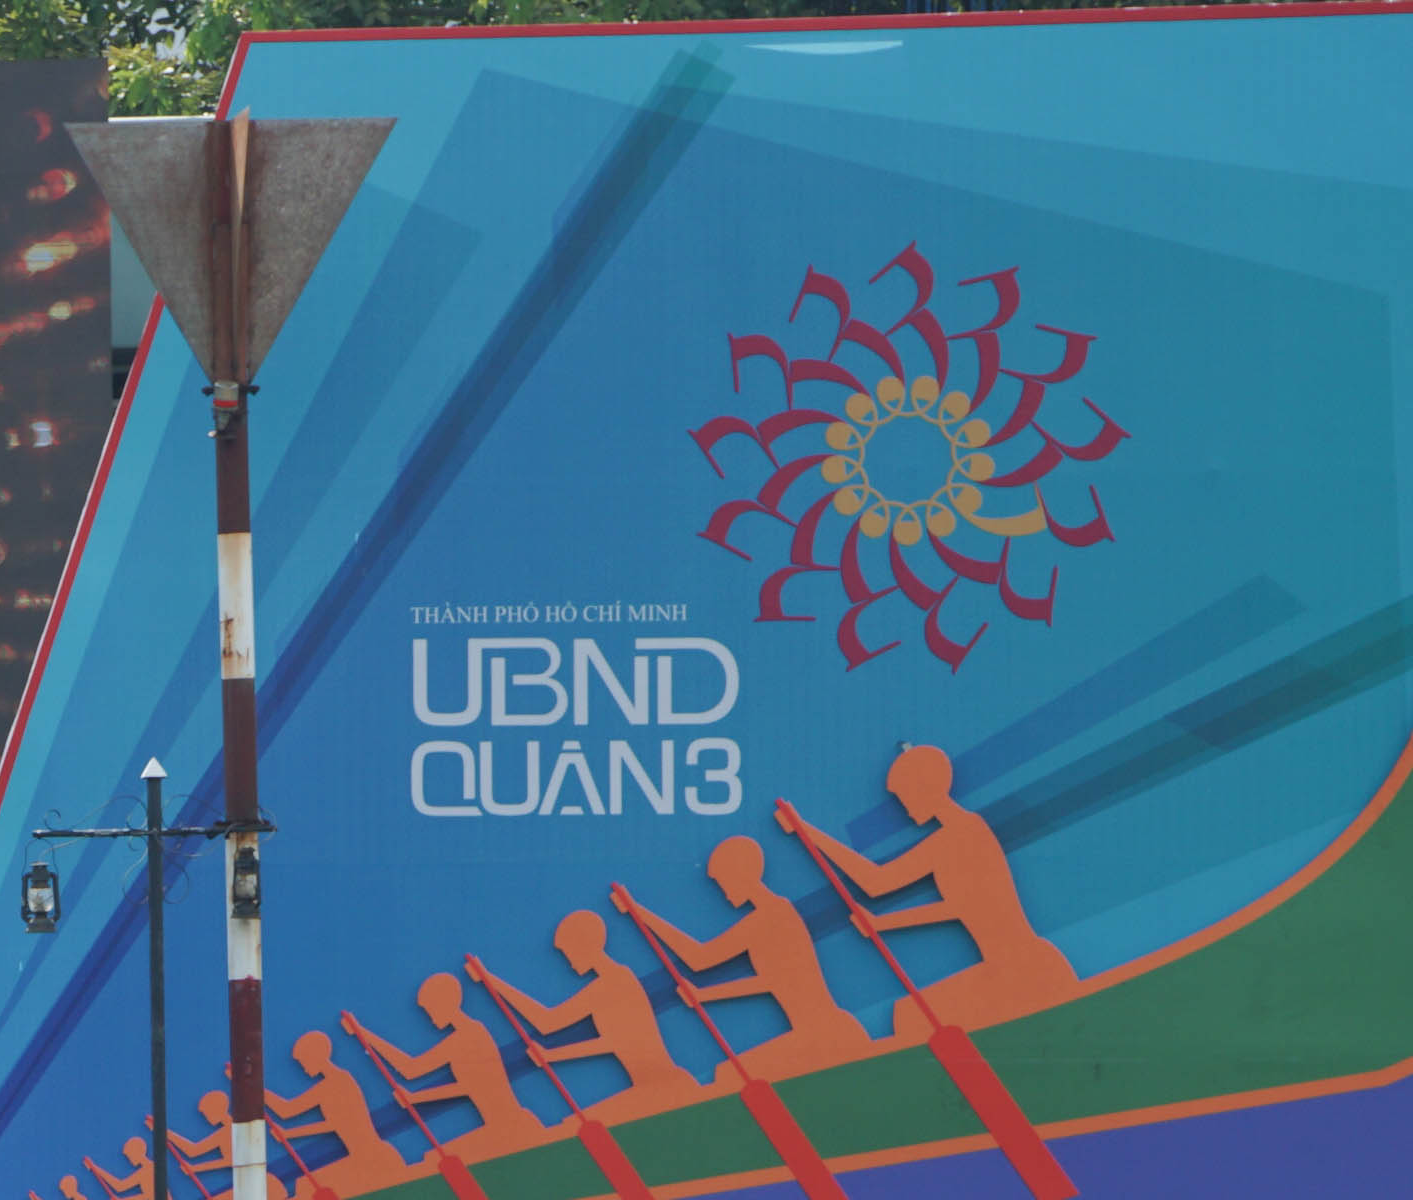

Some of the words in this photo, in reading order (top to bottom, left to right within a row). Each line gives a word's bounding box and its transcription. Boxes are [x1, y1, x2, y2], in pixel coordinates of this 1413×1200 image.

[411, 601, 488, 623] THÀNH
[583, 600, 621, 622] CHÍ
[628, 604, 687, 622] MINH
[412, 638, 740, 726] UBND
